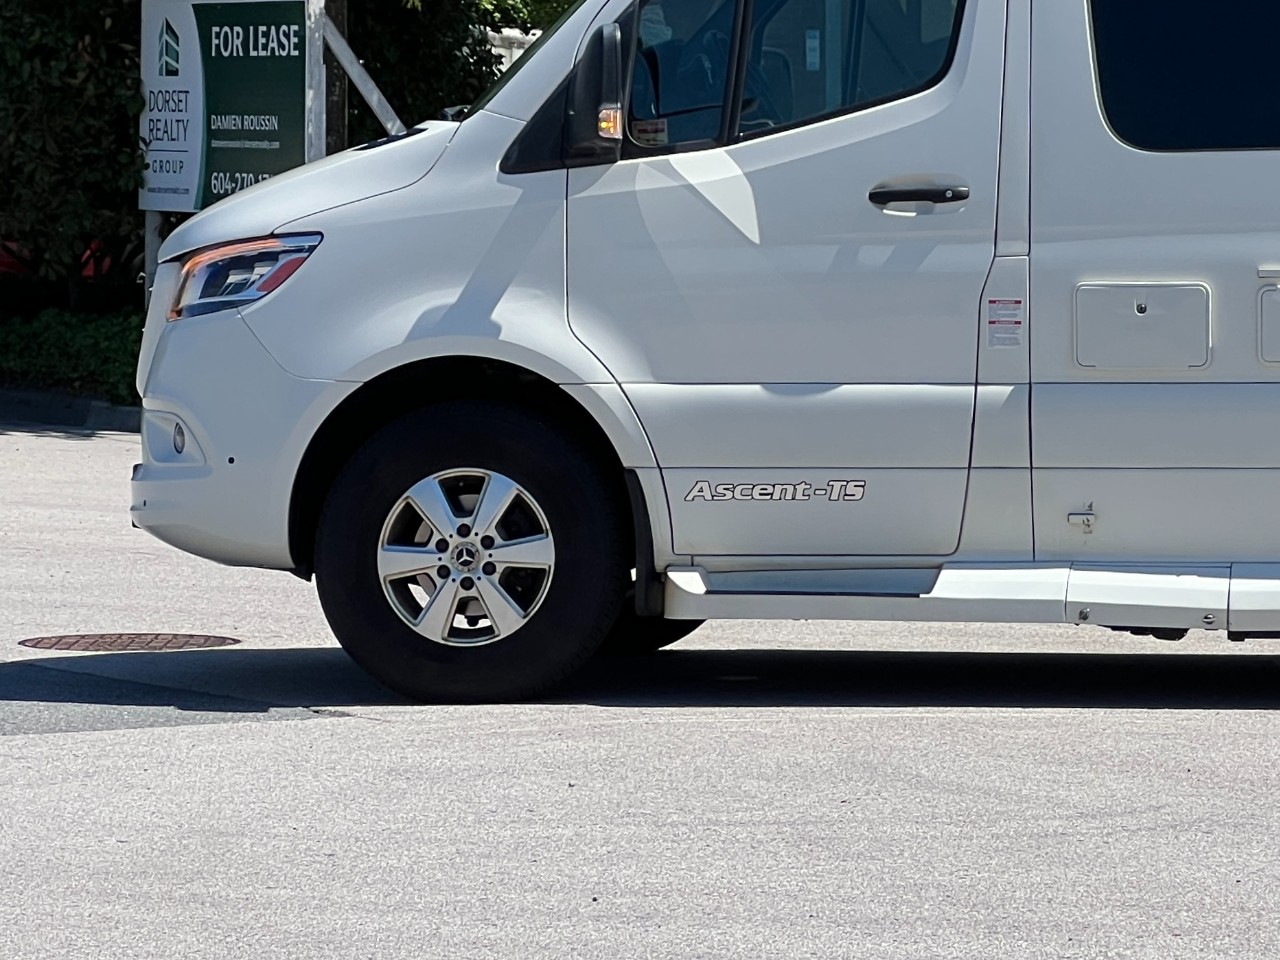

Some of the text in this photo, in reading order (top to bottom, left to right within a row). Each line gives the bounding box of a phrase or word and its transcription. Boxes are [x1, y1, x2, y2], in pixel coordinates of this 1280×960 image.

[211, 24, 299, 57] FOR LEASE
[148, 90, 190, 113] DORSET
[148, 118, 190, 142] REALTY
[210, 114, 279, 131] DAMIEN ROUSSIN
[151, 159, 184, 174] GROUP
[684, 479, 867, 502] Ascent-TS
